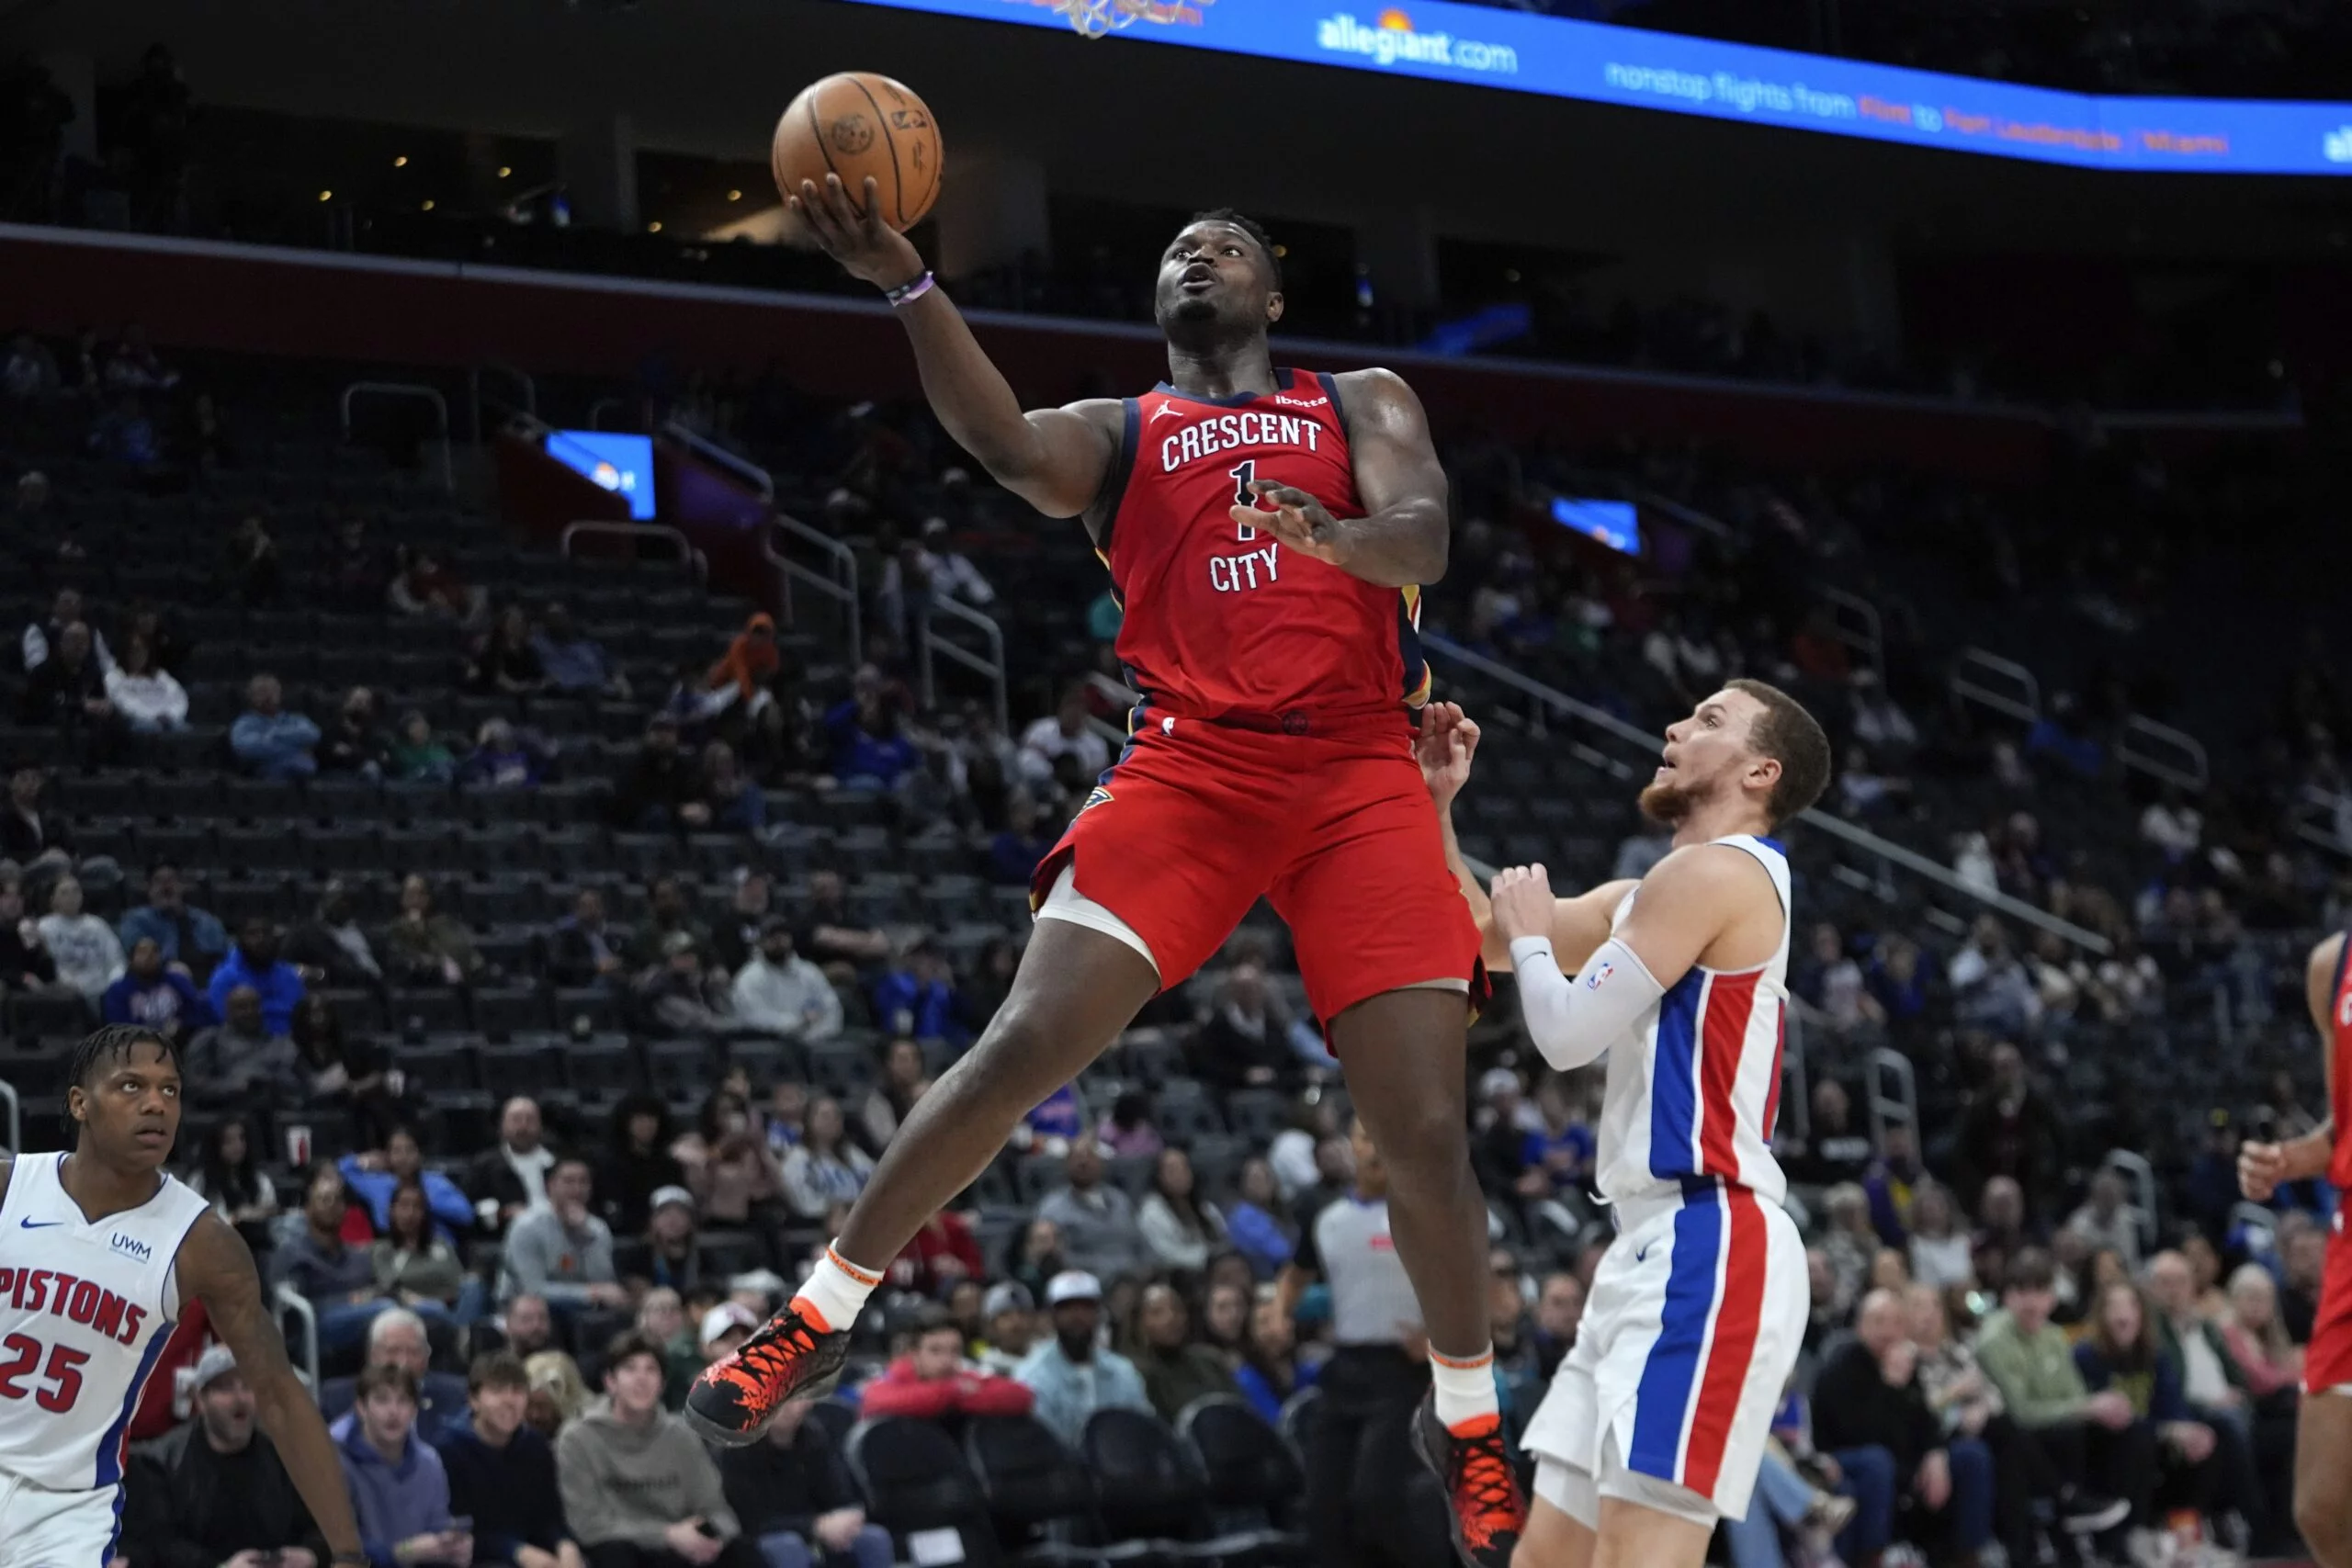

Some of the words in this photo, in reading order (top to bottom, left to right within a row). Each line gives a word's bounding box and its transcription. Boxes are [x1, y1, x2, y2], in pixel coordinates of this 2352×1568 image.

[1317, 12, 1519, 74] allegiant.com
[1792, 82, 1858, 119] from
[1912, 103, 1943, 132] to
[1275, 395, 1328, 407] ibotta
[1161, 412, 1322, 472] CRESCENT
[1229, 459, 1256, 540] 1
[1210, 543, 1278, 592] CITY
[112, 1232, 152, 1259] UWM
[0, 1332, 91, 1414] 25
